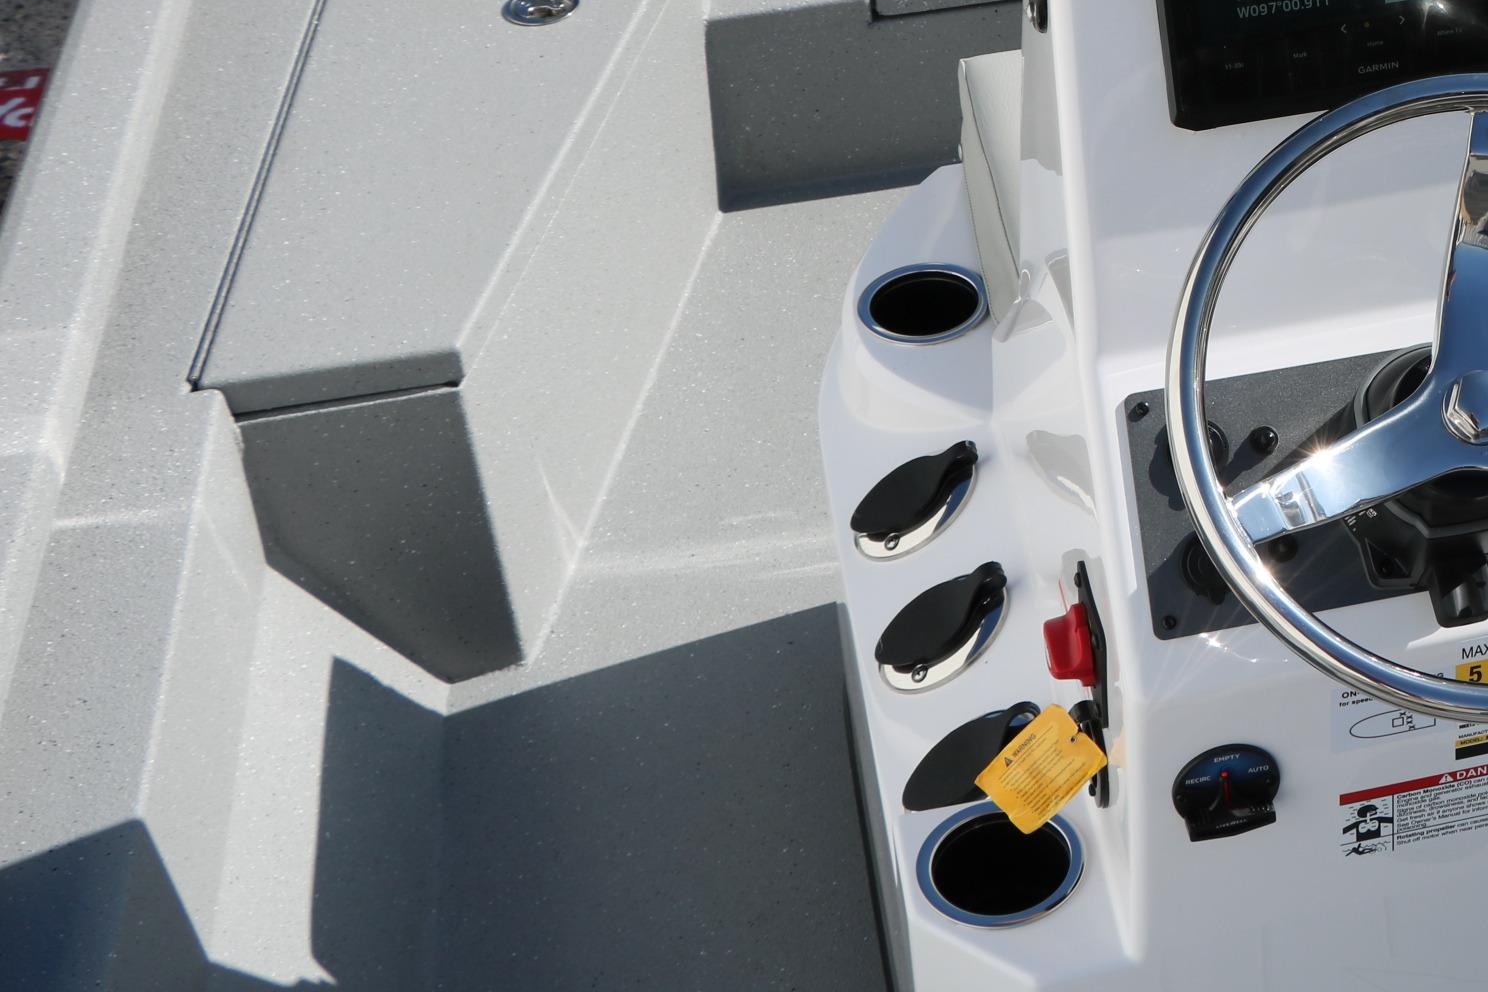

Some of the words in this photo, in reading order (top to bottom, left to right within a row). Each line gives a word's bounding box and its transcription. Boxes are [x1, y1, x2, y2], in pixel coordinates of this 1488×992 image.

[1358, 61, 1400, 76] GARMIN
[1469, 664, 1482, 683] 5
[1214, 754, 1240, 763] EMPTY
[1248, 765, 1269, 773] AUTO
[1185, 775, 1211, 785] RECIRC
